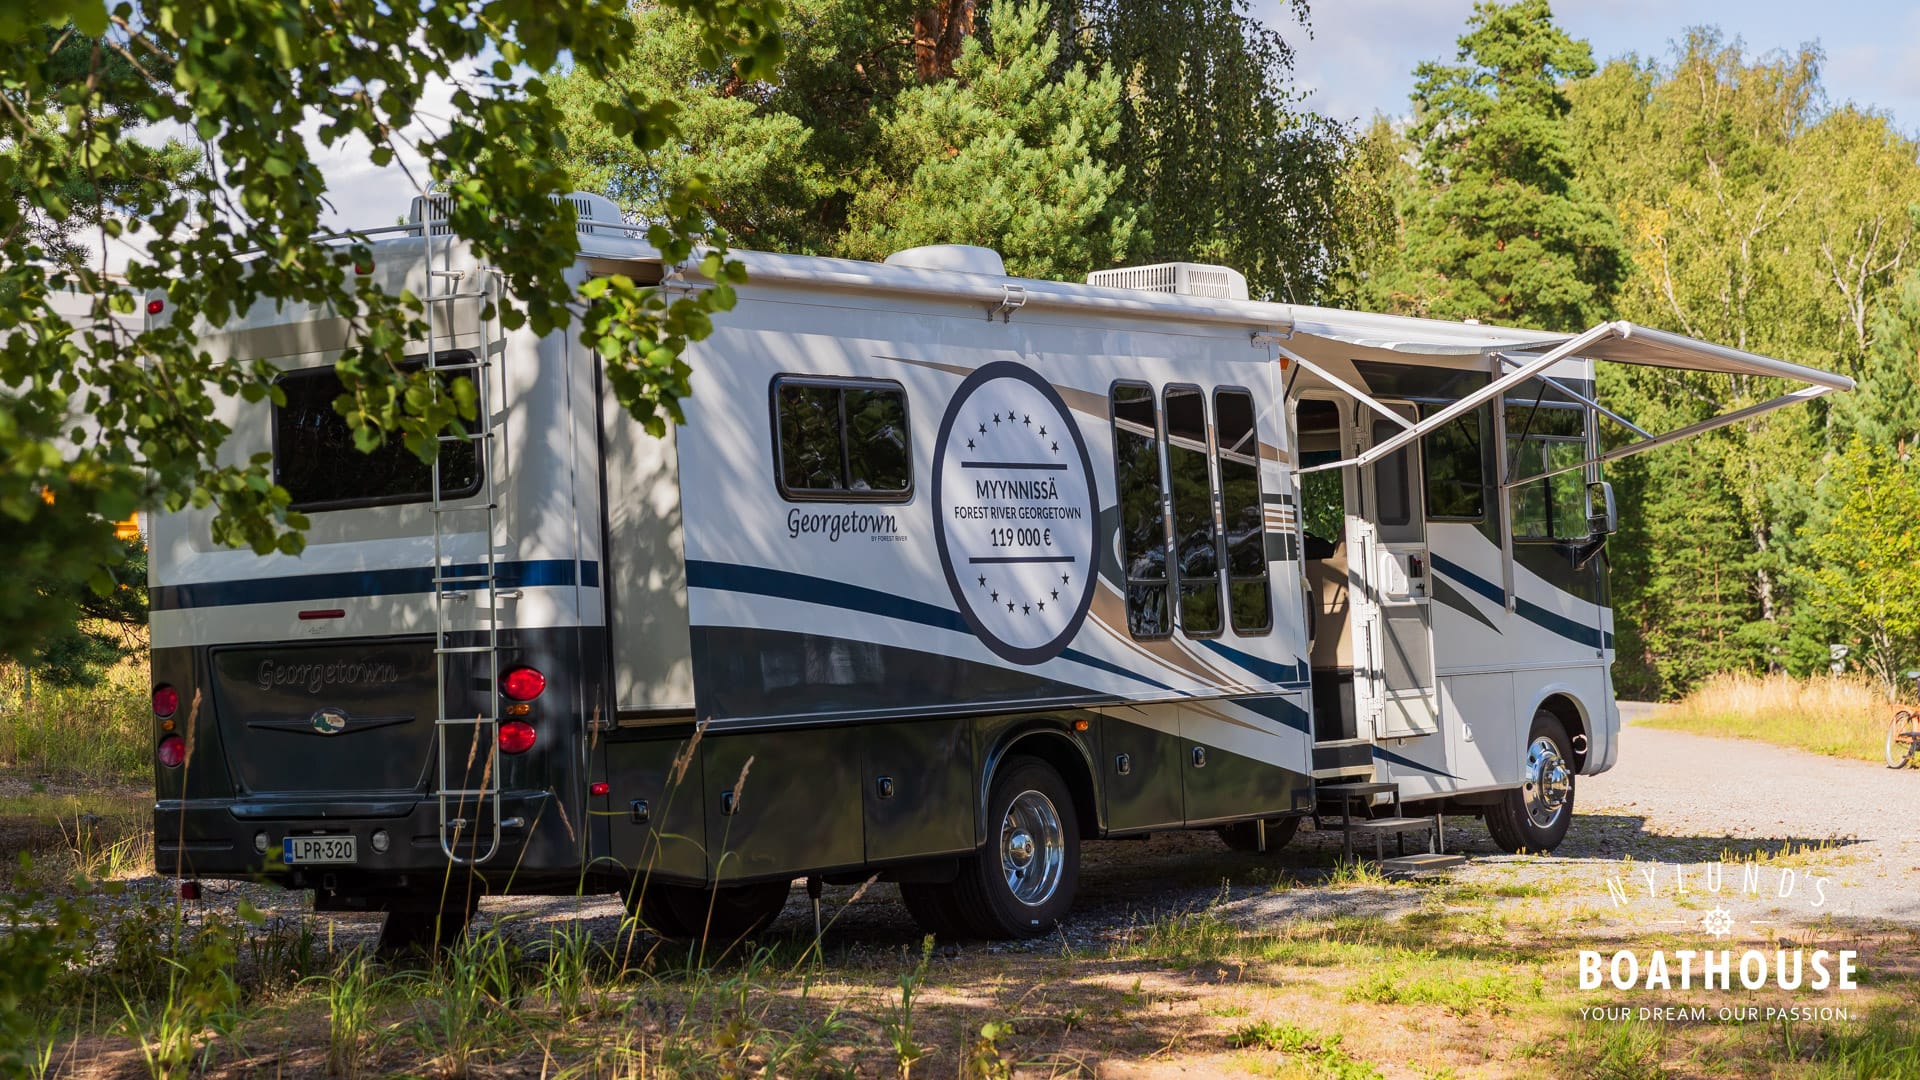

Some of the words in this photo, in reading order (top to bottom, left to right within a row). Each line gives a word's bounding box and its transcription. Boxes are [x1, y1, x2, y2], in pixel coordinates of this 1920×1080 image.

[976, 477, 1058, 500] MYYNNISSÄ
[954, 506, 988, 519] FOREST
[991, 506, 1017, 519] RIVER
[1019, 506, 1082, 520] GEORGETOWN
[787, 508, 898, 542] Georgetown
[990, 528, 1014, 546] 119
[1017, 528, 1040, 546] 000
[1043, 528, 1051, 546] €
[257, 659, 399, 694] Georgetown
[295, 841, 352, 860] LPR-320
